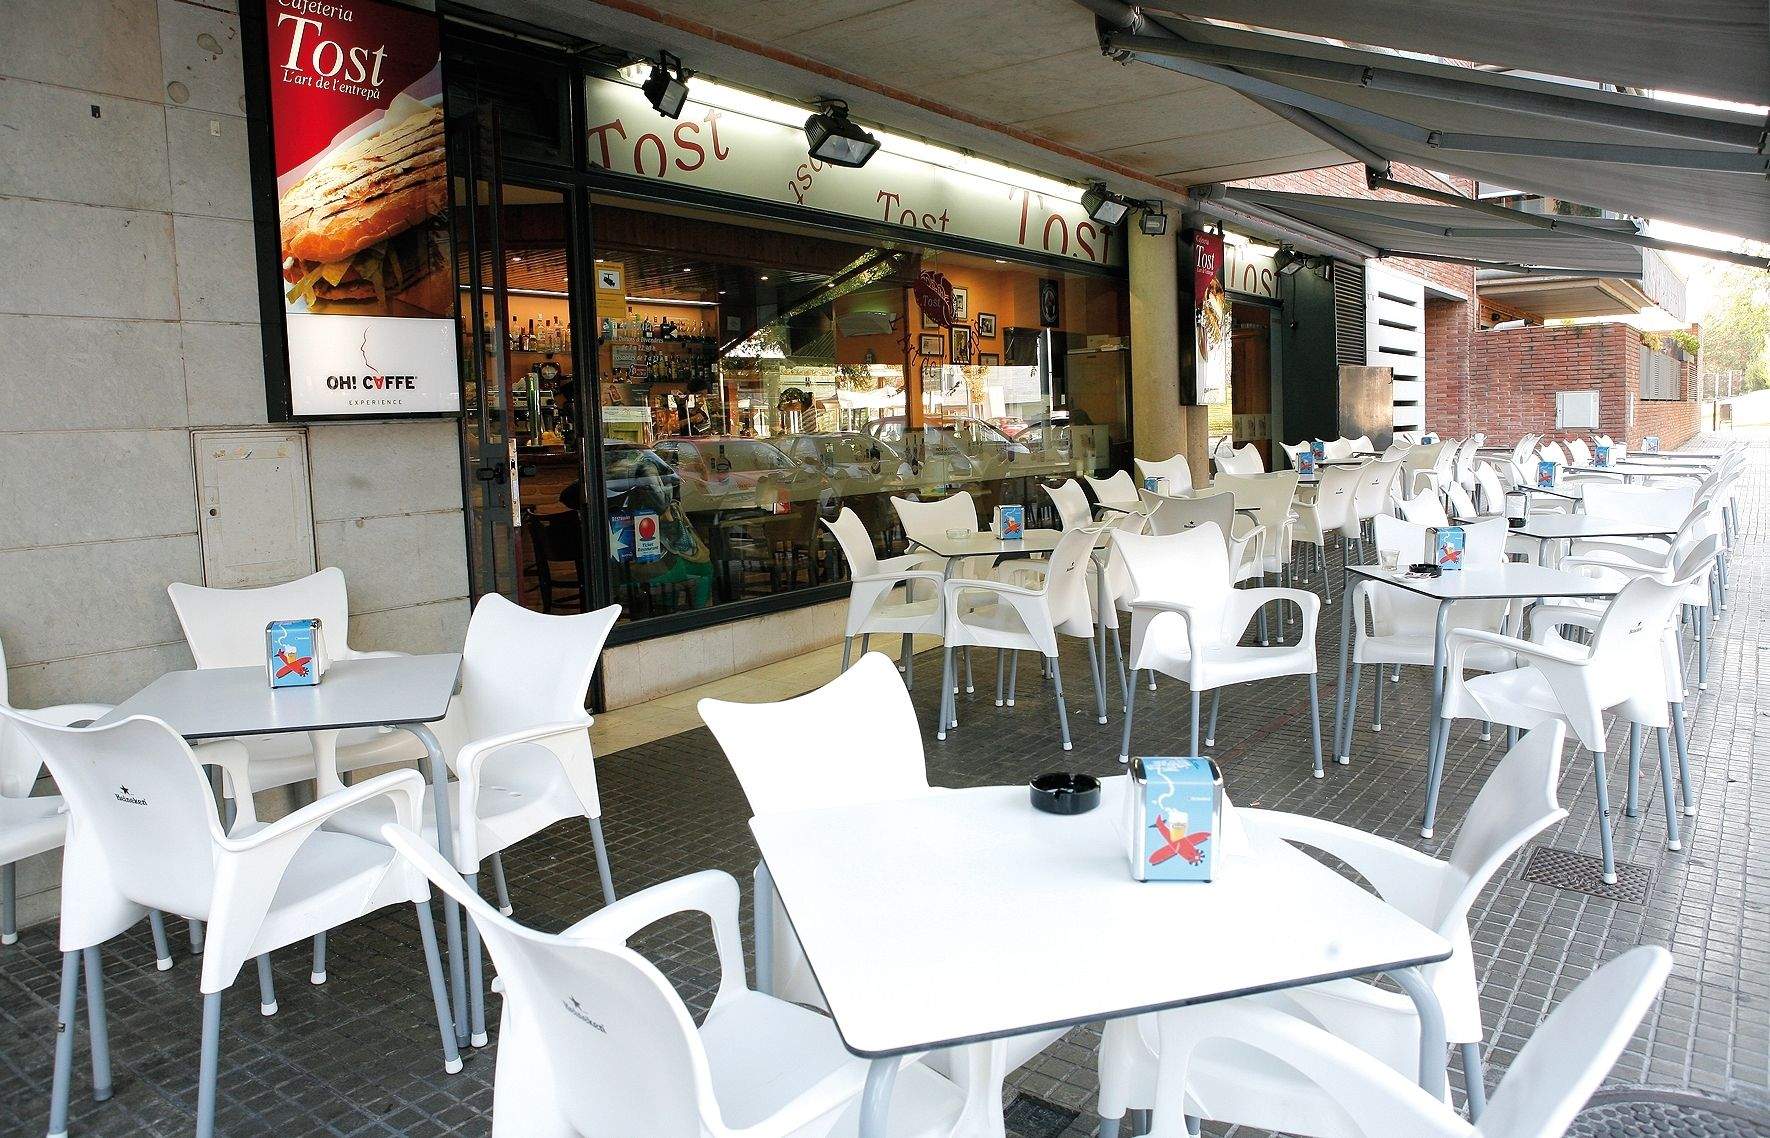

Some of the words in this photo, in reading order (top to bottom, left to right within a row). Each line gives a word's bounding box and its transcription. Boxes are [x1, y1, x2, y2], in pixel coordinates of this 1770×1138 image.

[277, 12, 388, 87] Tost
[282, 69, 313, 87] L'art
[315, 76, 331, 90] de
[332, 78, 381, 101] l'entrepà
[587, 110, 730, 178] Tost
[876, 189, 950, 233] Tost
[1008, 187, 1111, 265] Tost
[1196, 245, 1215, 271] Tost
[326, 375, 357, 391] OH!
